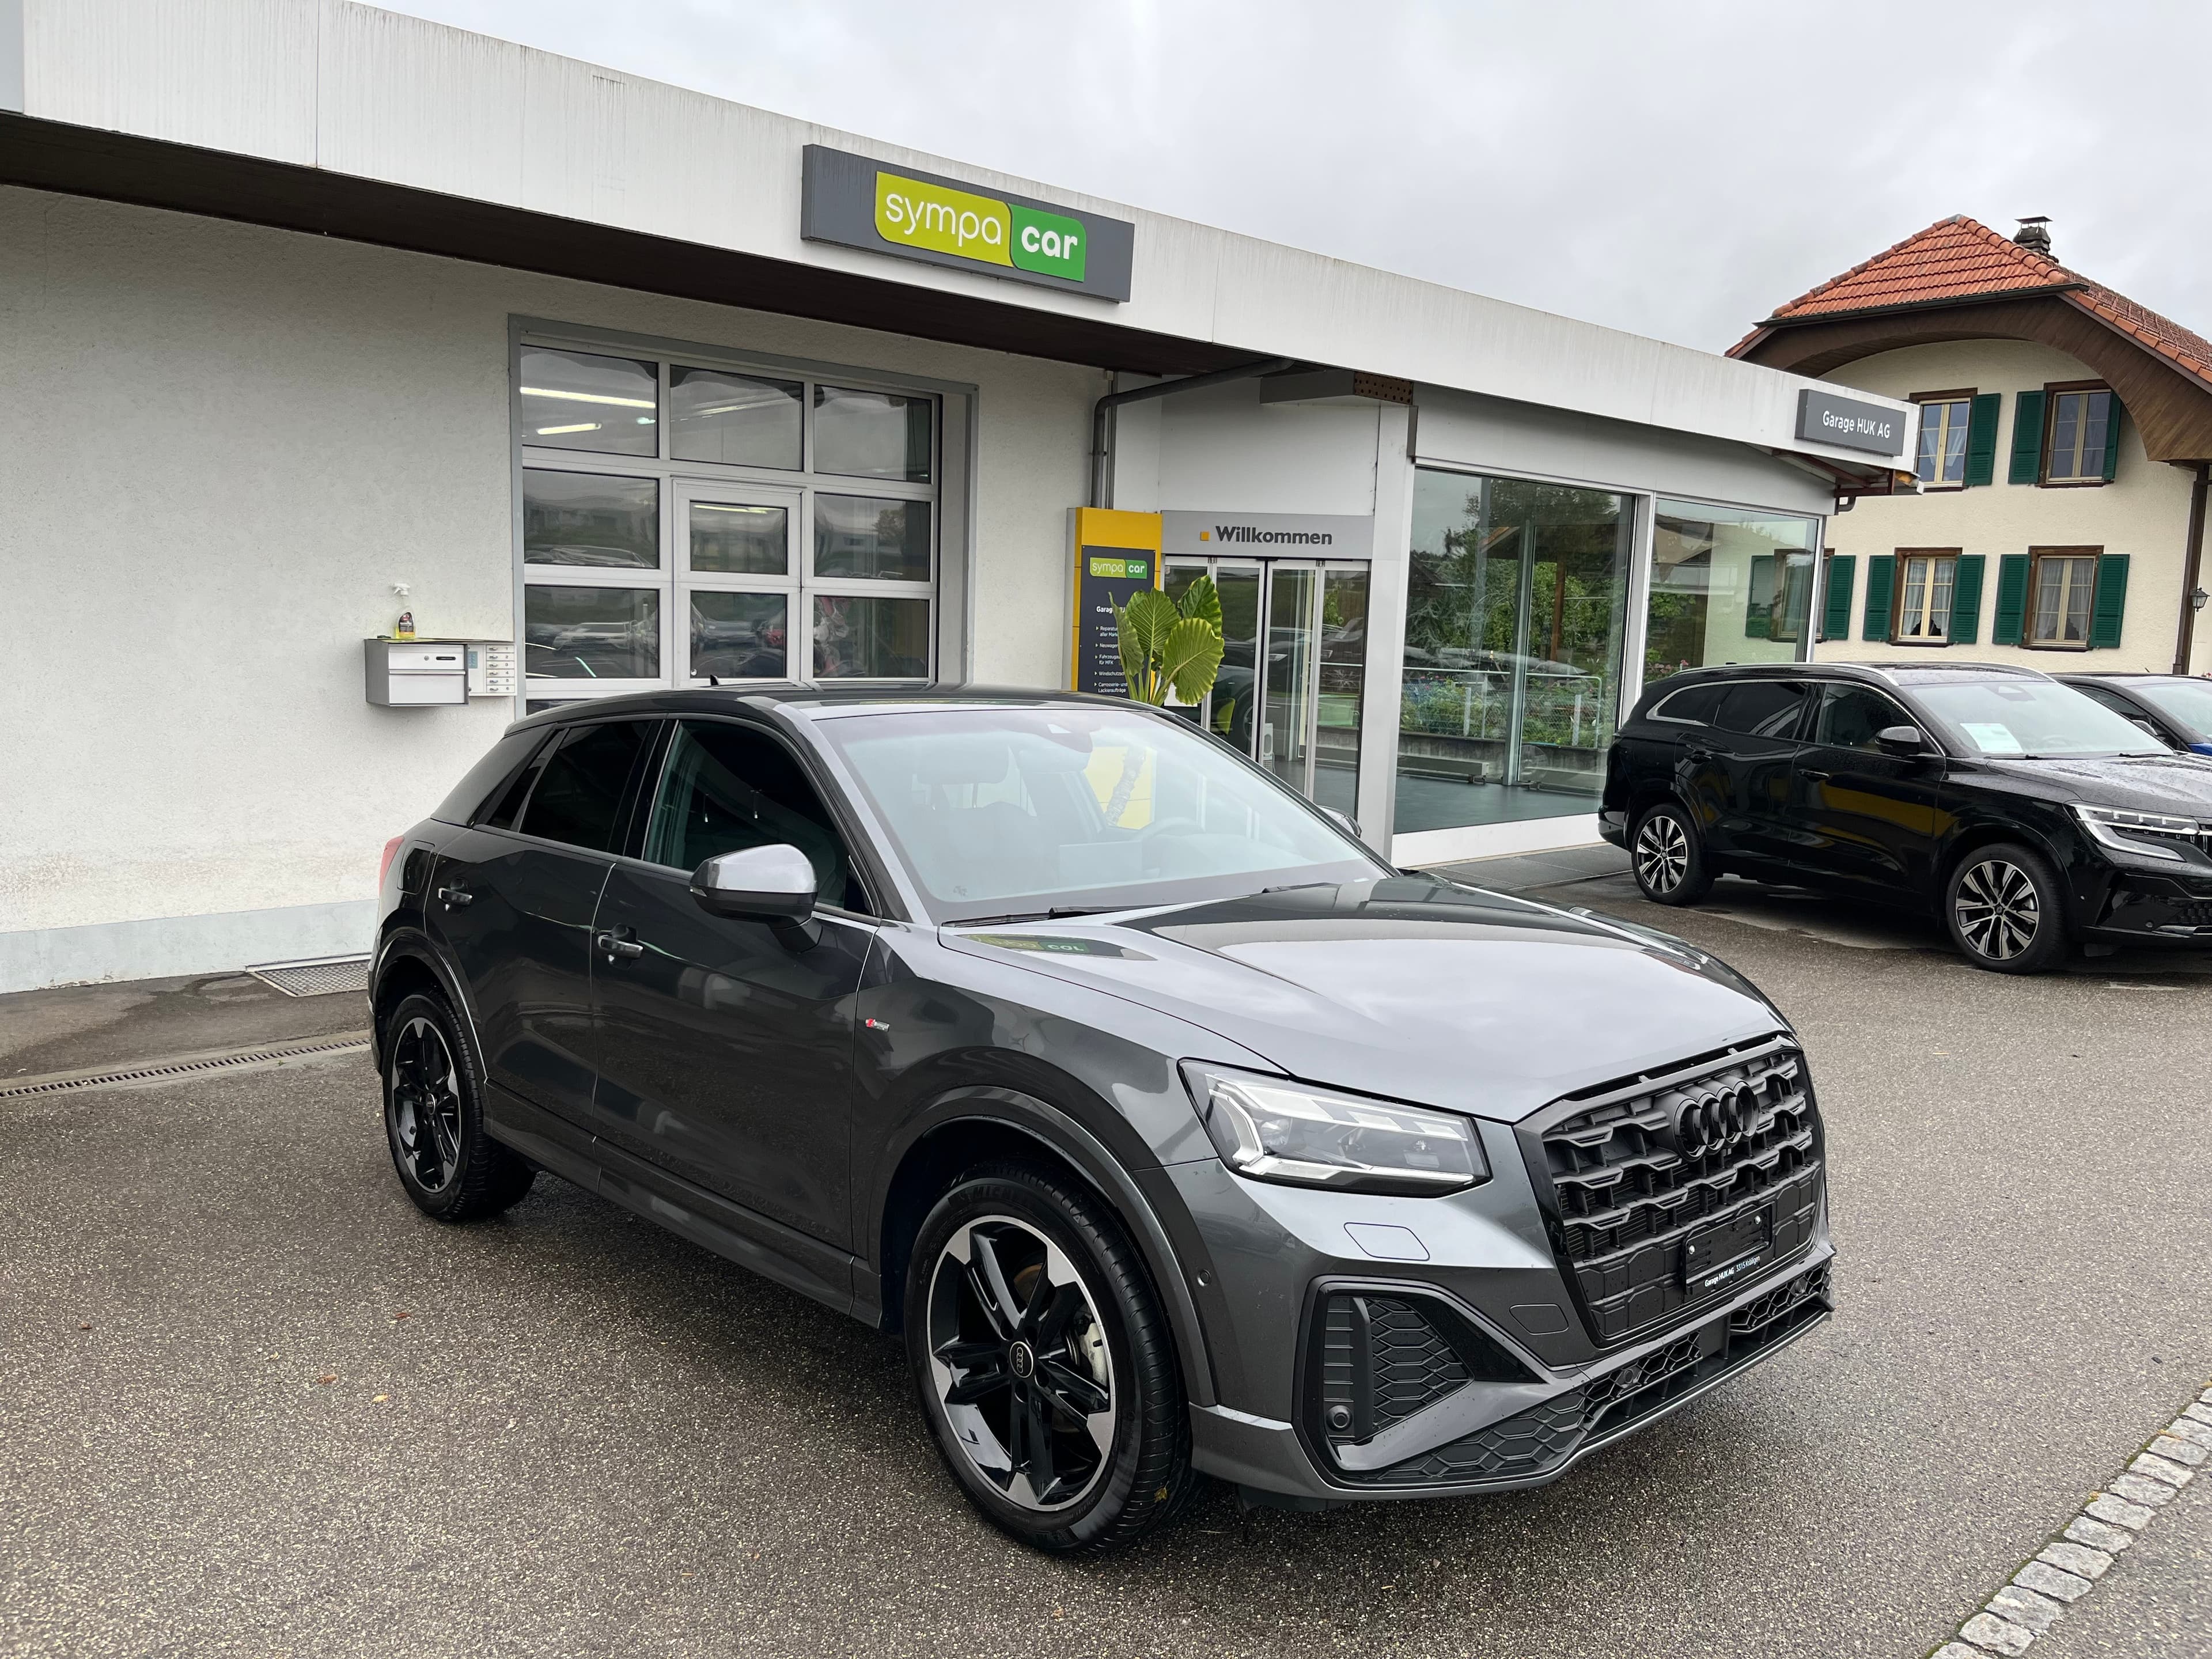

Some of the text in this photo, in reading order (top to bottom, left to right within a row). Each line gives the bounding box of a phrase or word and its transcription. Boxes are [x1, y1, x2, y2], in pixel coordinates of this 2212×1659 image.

[886, 194, 1078, 260] sympa car
[1823, 410, 1890, 438] Garage HUK AG
[1215, 526, 1332, 545] Willkommen
[1092, 561, 1145, 574] sympa car
[1096, 606, 1113, 614] Garag
[1705, 1276, 1719, 1287] Garage
[1718, 1270, 1728, 1280] HUK
[1728, 1267, 1734, 1276] AG
[1736, 1262, 1745, 1272] 3315
